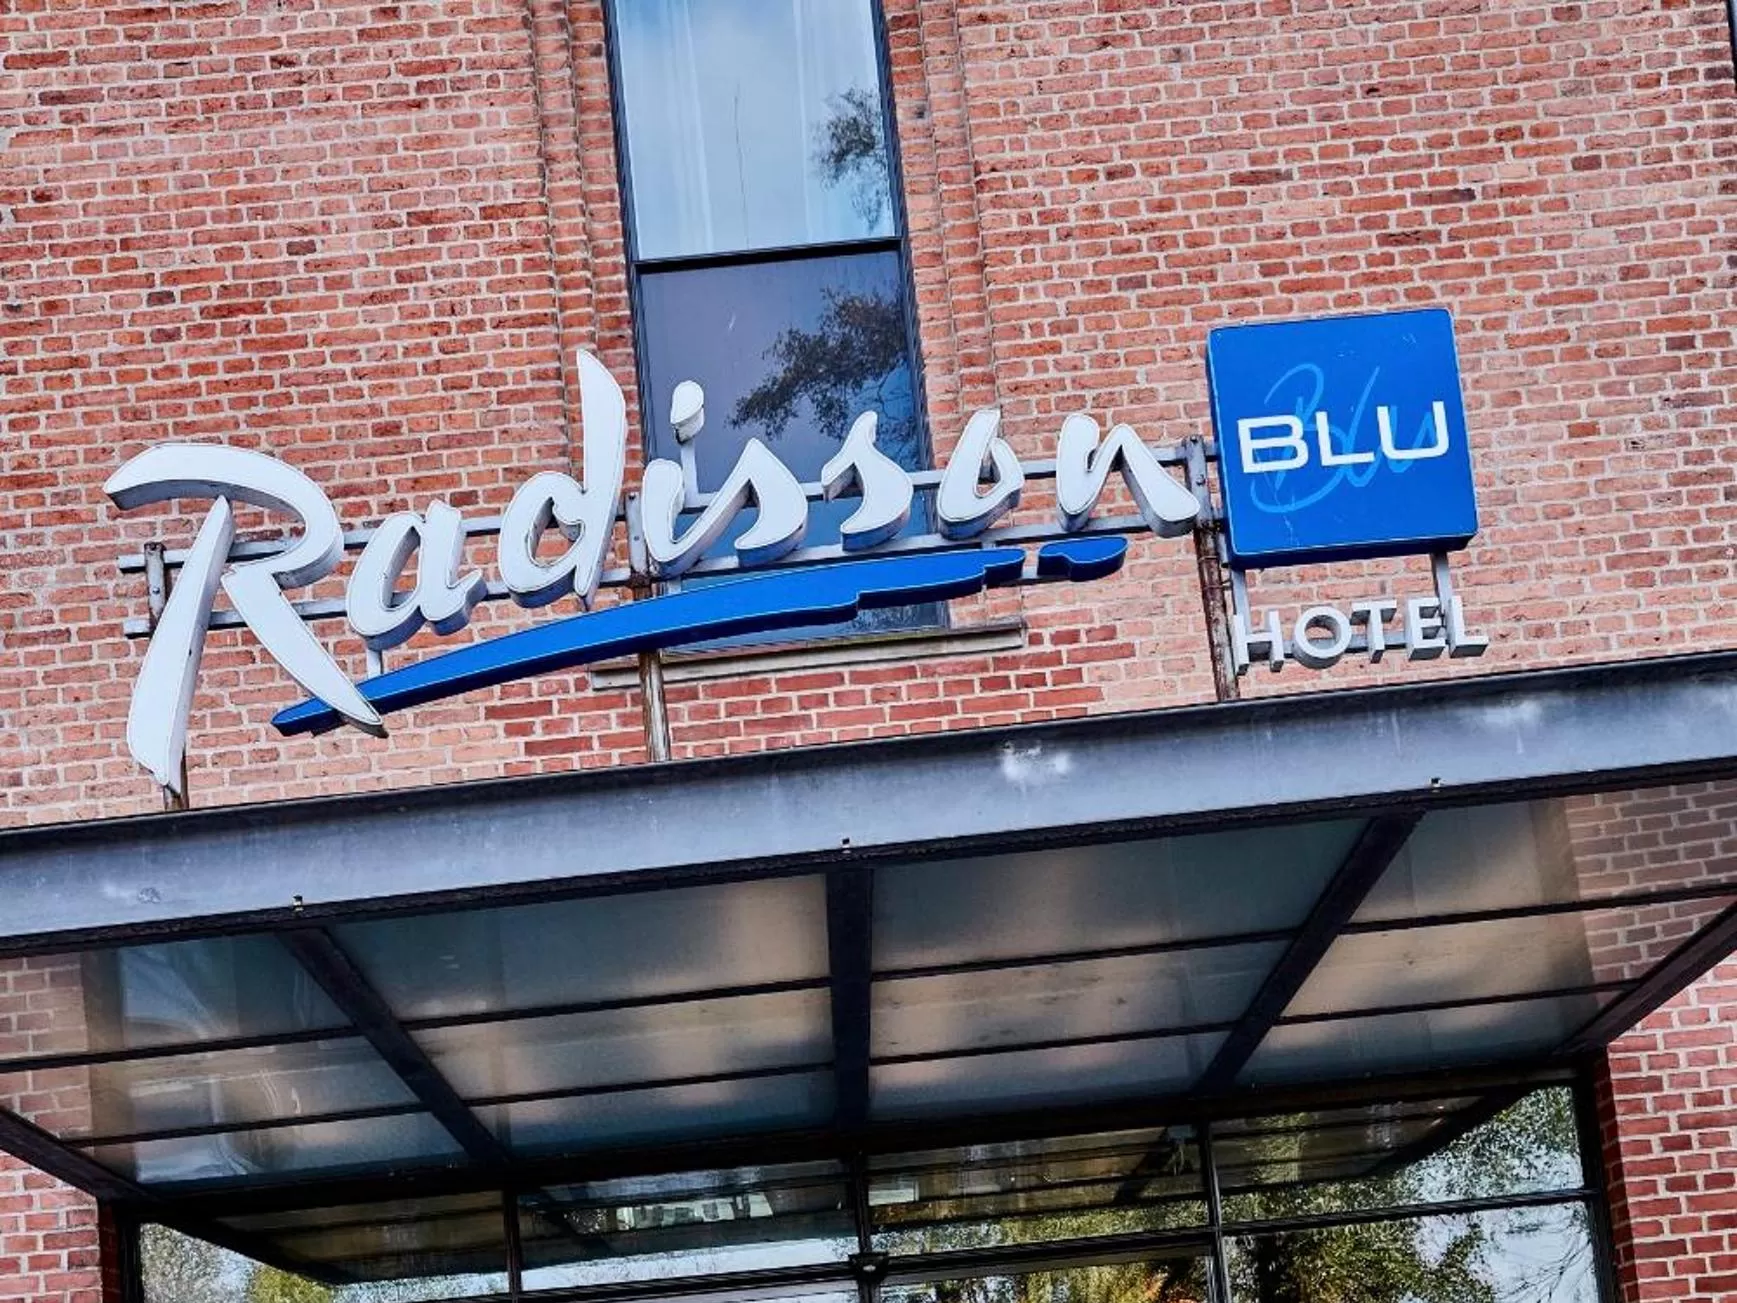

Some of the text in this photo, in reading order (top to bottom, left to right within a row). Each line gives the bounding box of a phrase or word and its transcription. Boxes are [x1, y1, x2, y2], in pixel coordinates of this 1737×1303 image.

[1236, 401, 1450, 474] BLU
[103, 349, 1200, 793] Radisson
[1233, 596, 1489, 675] HOTEL
